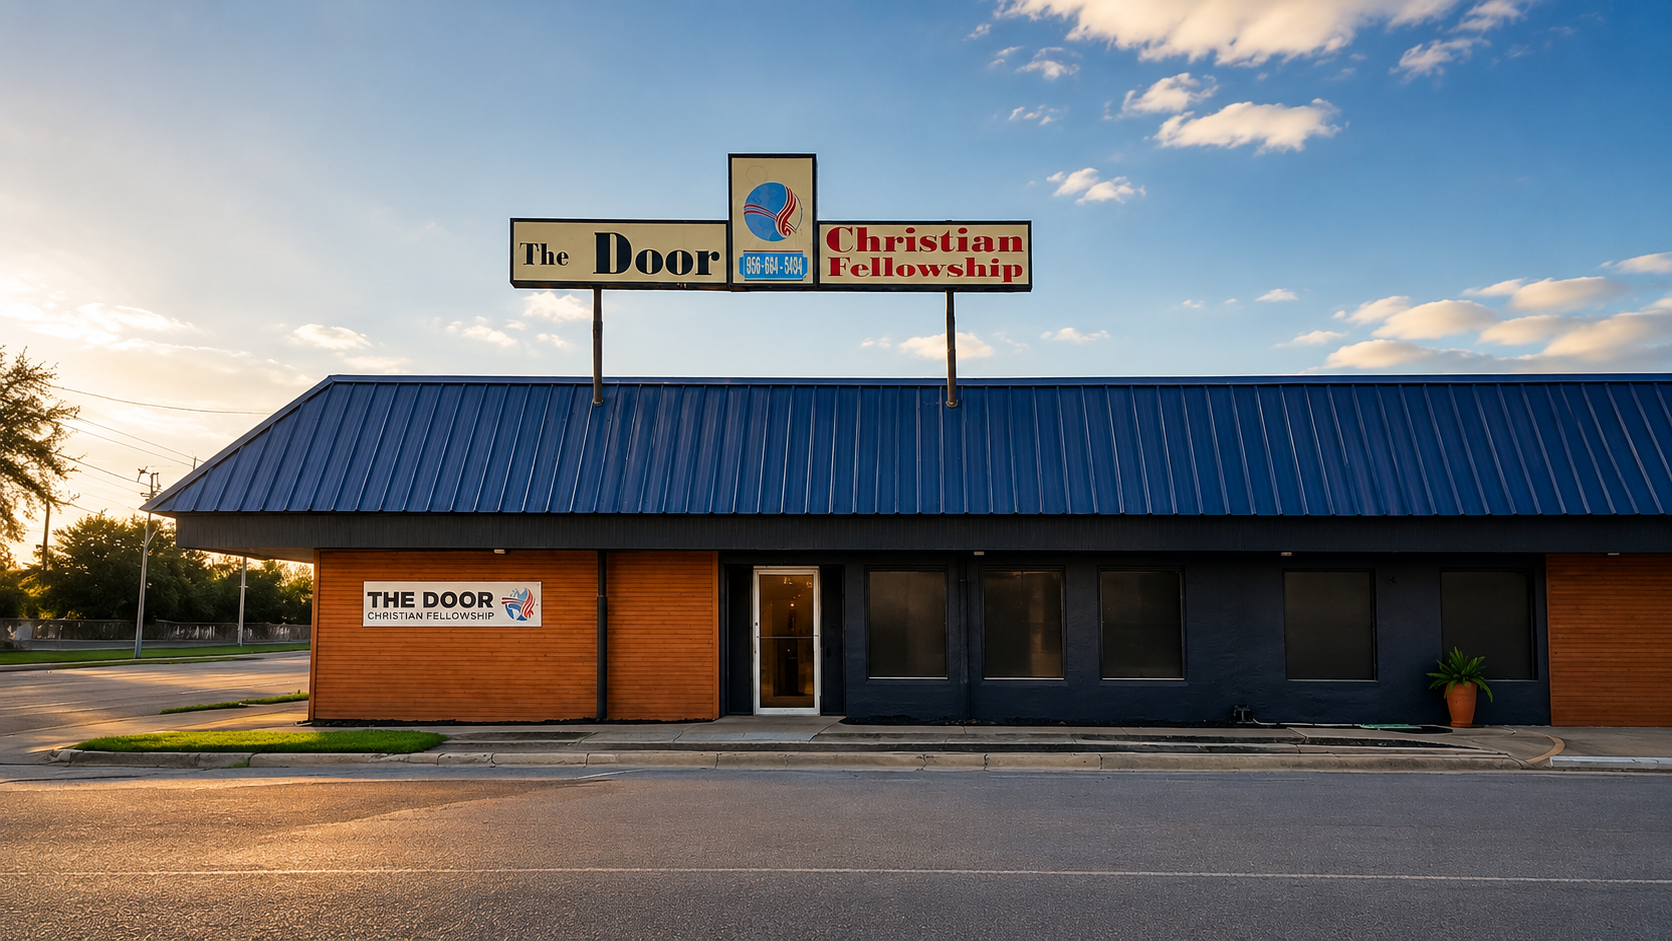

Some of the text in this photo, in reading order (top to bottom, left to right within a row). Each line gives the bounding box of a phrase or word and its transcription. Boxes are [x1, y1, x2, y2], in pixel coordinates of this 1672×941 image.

[826, 226, 1024, 253] Christian
[519, 232, 720, 275] The Door
[828, 257, 1024, 283] Fellowship
[367, 591, 494, 609] THE DOOR
[367, 611, 495, 620] CHRISTIAN FELLOWSHIP
